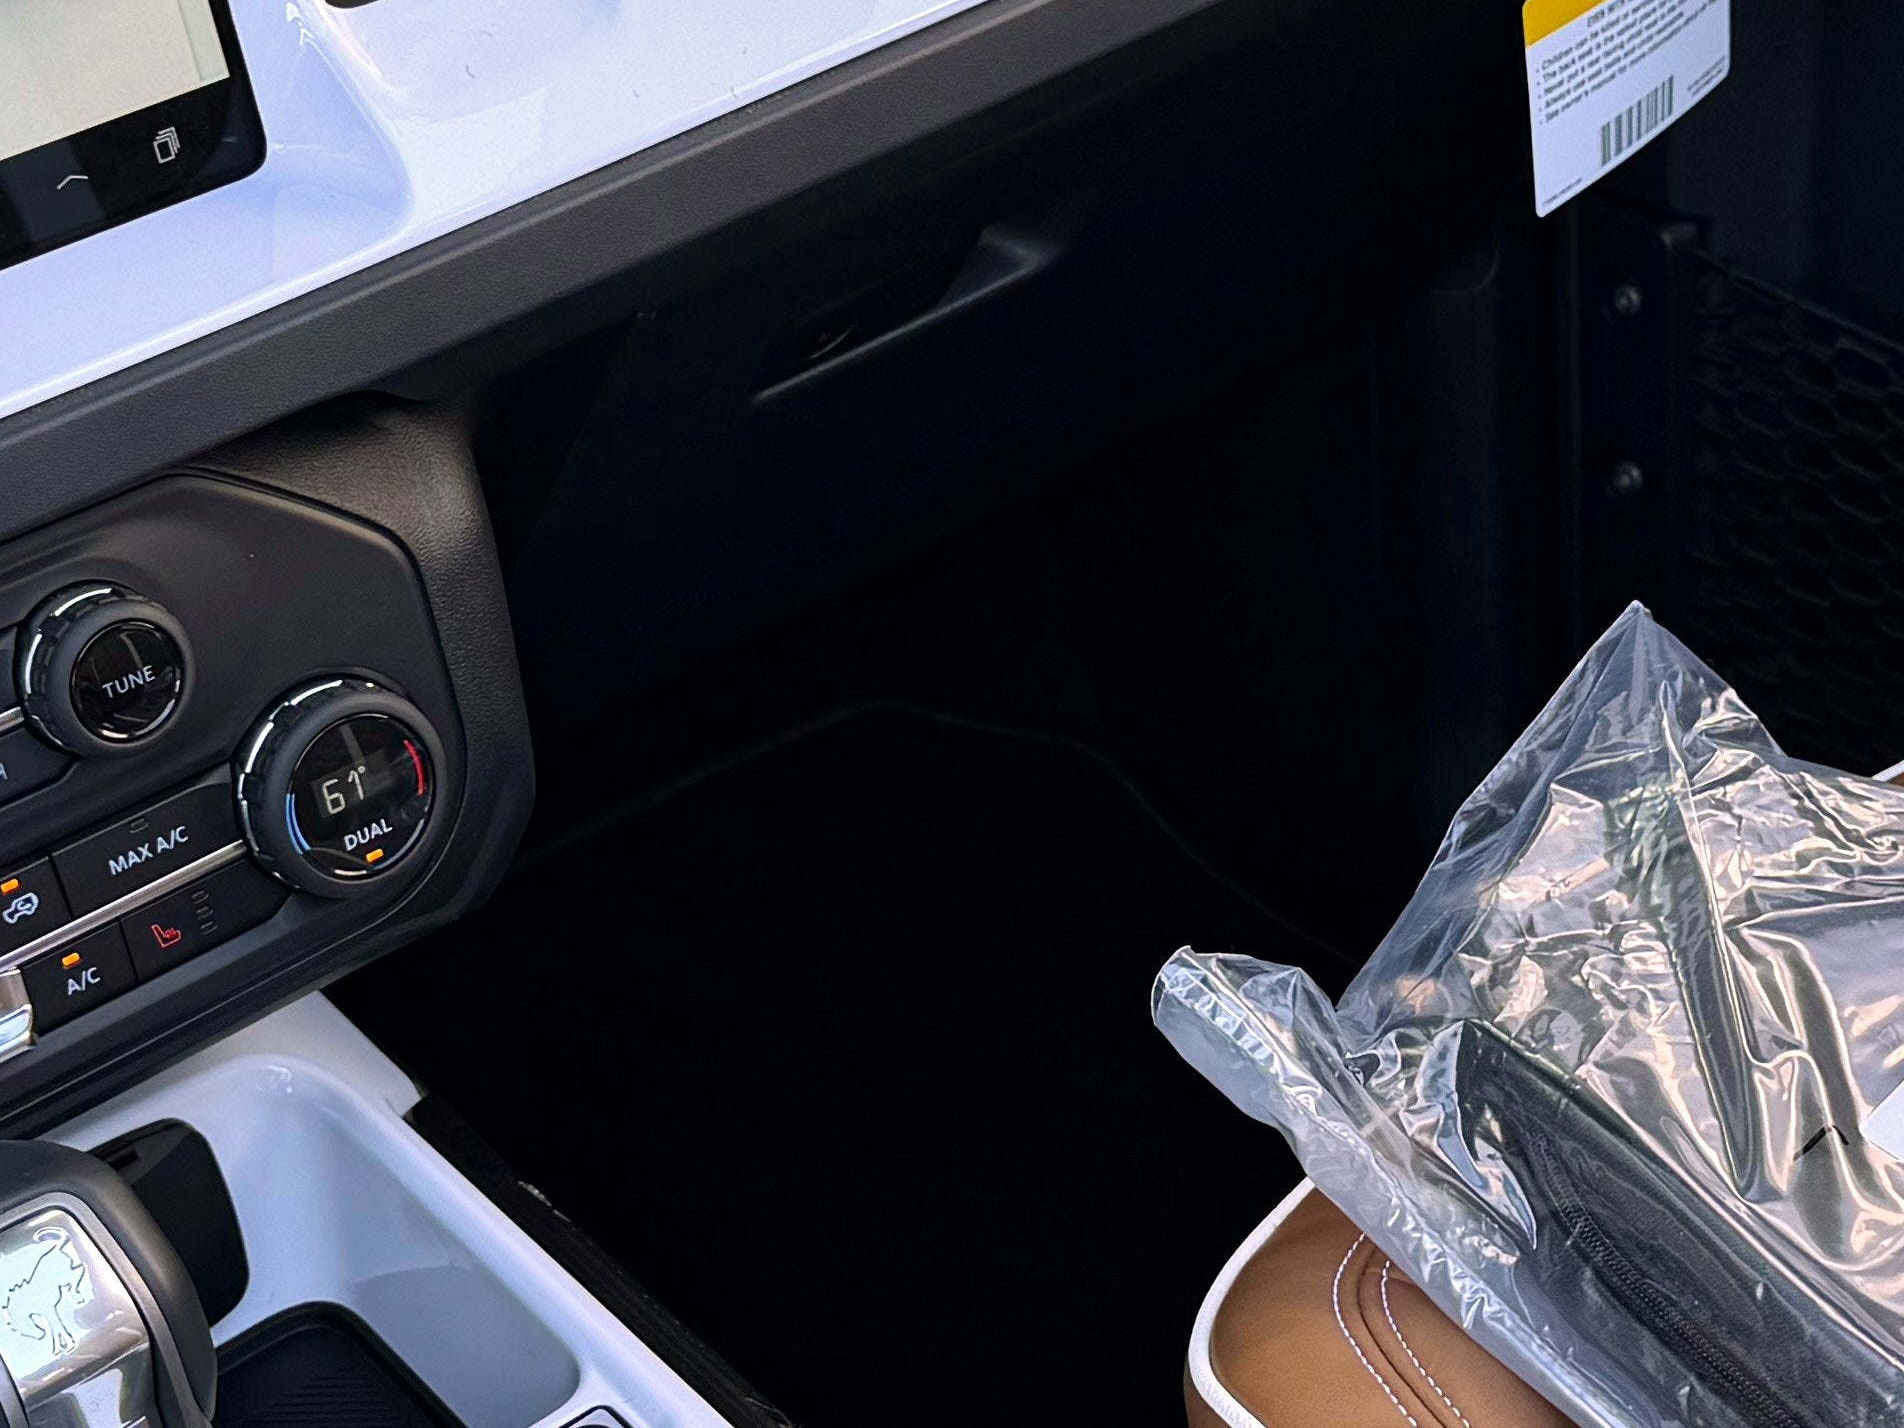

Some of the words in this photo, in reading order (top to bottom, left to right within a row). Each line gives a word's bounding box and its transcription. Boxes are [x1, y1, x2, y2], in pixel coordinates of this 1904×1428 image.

[103, 664, 157, 701] TUNE
[108, 840, 153, 876] MAX
[150, 824, 190, 857] A/C
[344, 818, 393, 851] DUAL
[66, 966, 102, 998] A/C
